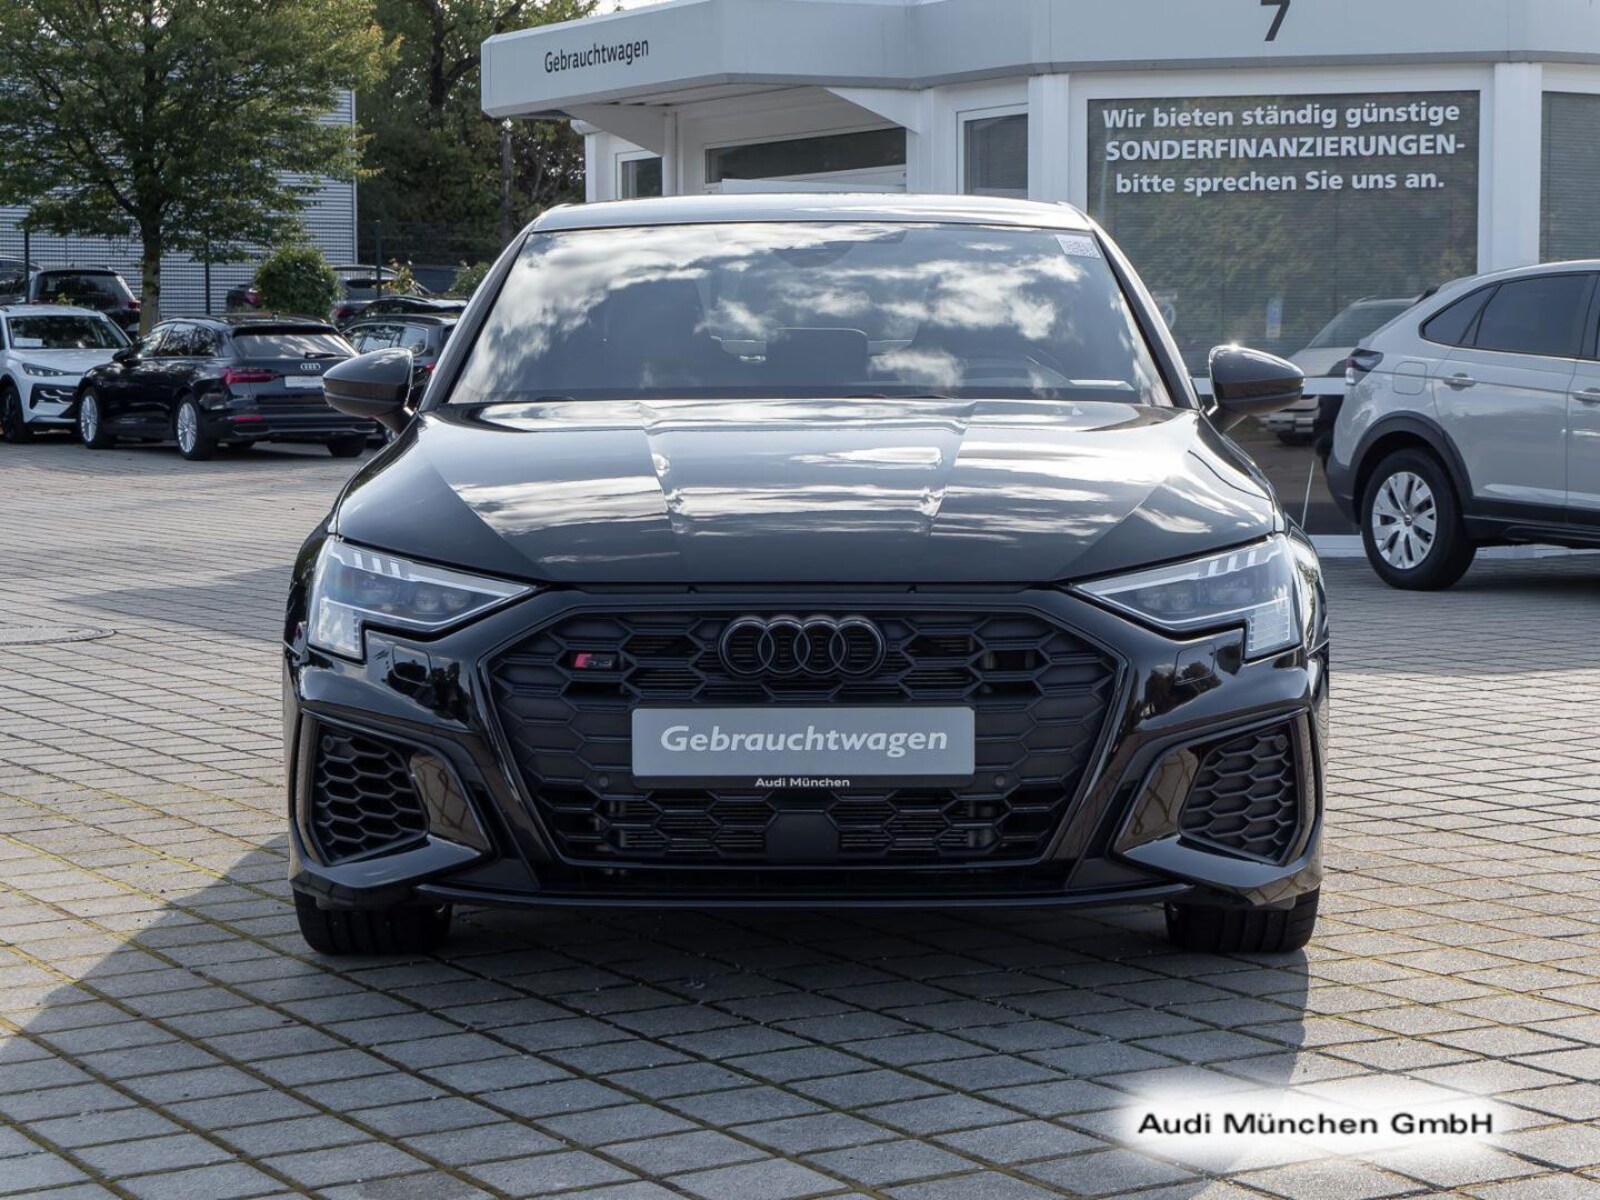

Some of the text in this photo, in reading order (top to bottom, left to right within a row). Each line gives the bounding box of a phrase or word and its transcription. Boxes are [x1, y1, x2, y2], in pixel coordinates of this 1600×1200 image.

[1260, 0, 1291, 42] 7
[544, 39, 649, 73] Gebrauchtwagen
[1103, 101, 1460, 129] Wir bieten ständig günstige
[1105, 133, 1466, 161] SONDERFINANZIERUNGEN-
[1116, 169, 1445, 197] bitte sprechen Sie uns an.
[660, 724, 949, 758] Gebrauchtwagen
[754, 776, 851, 788] Audi München
